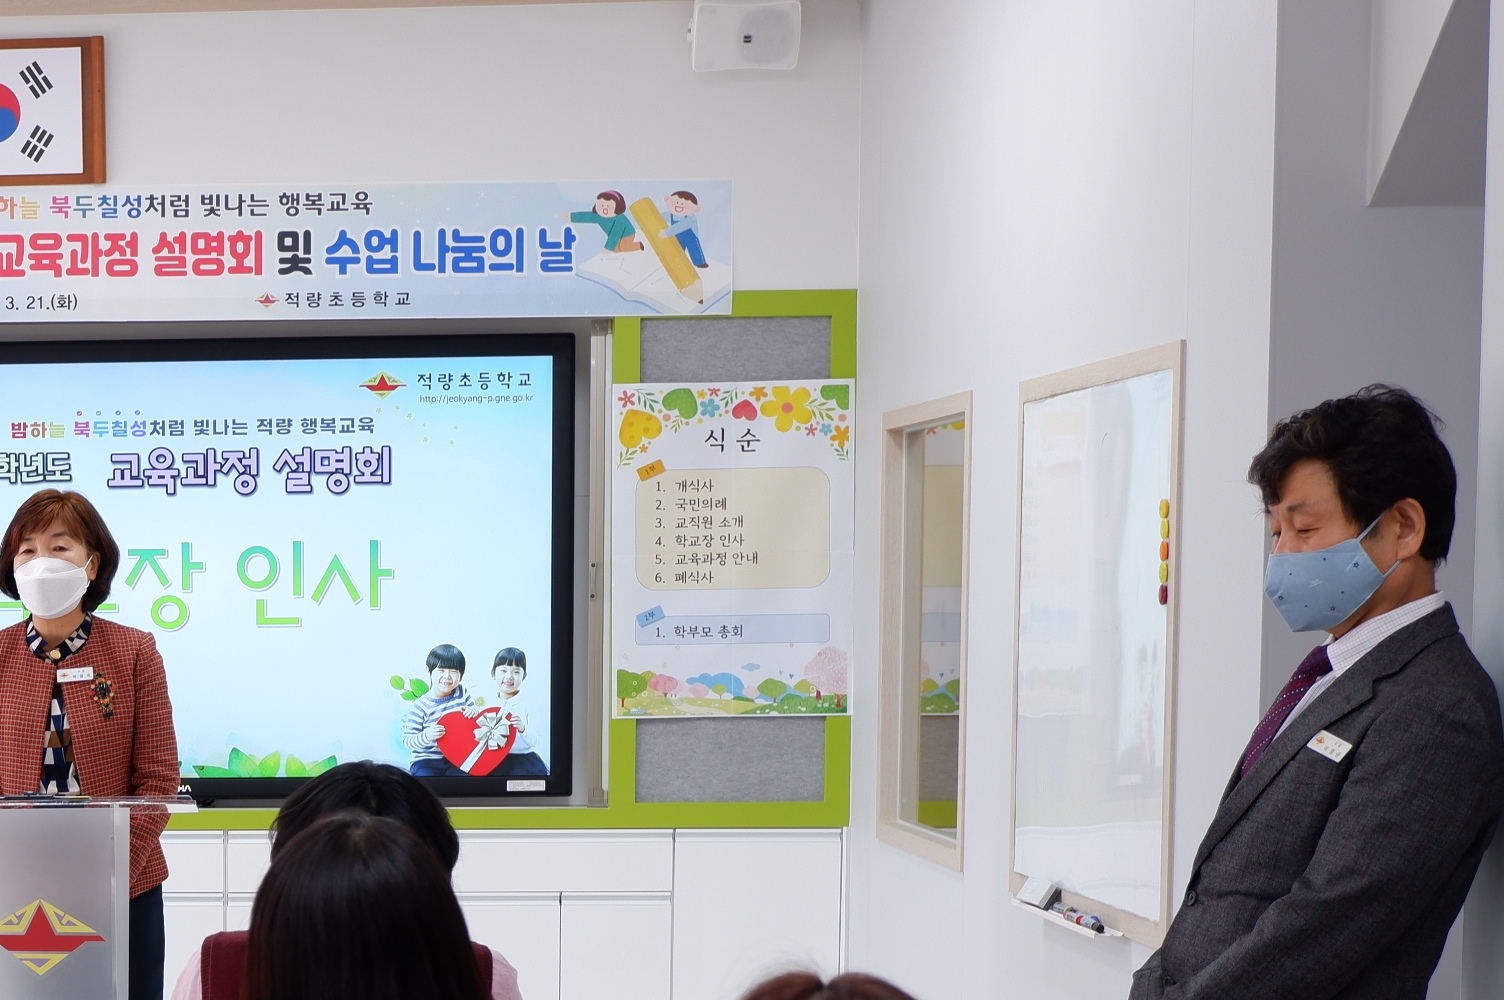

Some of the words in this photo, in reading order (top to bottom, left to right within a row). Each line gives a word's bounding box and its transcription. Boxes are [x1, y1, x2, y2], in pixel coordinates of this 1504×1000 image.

[49, 194, 190, 220] 북두칠성처럼
[200, 193, 270, 218] 빛나는
[278, 191, 373, 217] 행복교육
[151, 230, 263, 277] 설명회
[276, 229, 313, 275] 및
[324, 229, 398, 275] 수업
[412, 227, 525, 274] 나눔의
[538, 226, 577, 273] 날
[5, 296, 20, 311] 3.
[26, 293, 78, 312] 21.(화)
[284, 290, 411, 309] 적량초등학교
[417, 372, 532, 391] 적량초등학교
[419, 394, 534, 405] http://jeokyang-p.gne.go.kr
[10, 421, 66, 439] 밤하늘
[73, 418, 186, 438] 북두칠성처럼
[193, 418, 249, 437] 빛나는
[256, 417, 293, 436] 적량
[300, 416, 376, 435] 행복교육
[107, 447, 260, 496] 교육과정
[272, 445, 392, 495] 설명회
[654, 482, 667, 494] 1.
[674, 480, 715, 494] 개식사
[654, 499, 667, 512] 2.
[674, 497, 727, 512] 국민의례
[654, 517, 667, 530] 3.
[674, 515, 713, 530] 교직원
[718, 514, 744, 528] 소개
[654, 535, 667, 549] 4.
[674, 533, 715, 549] 학교장
[719, 532, 745, 547] 인사
[654, 553, 667, 567] 5.
[674, 551, 727, 567] 교육과정
[732, 550, 758, 565] 안내
[236, 540, 395, 628] 인사
[654, 572, 667, 585] 6.
[674, 570, 715, 585] 폐식사
[654, 626, 666, 639] 1.
[673, 624, 714, 639] 학부모
[717, 623, 743, 639] 총회
